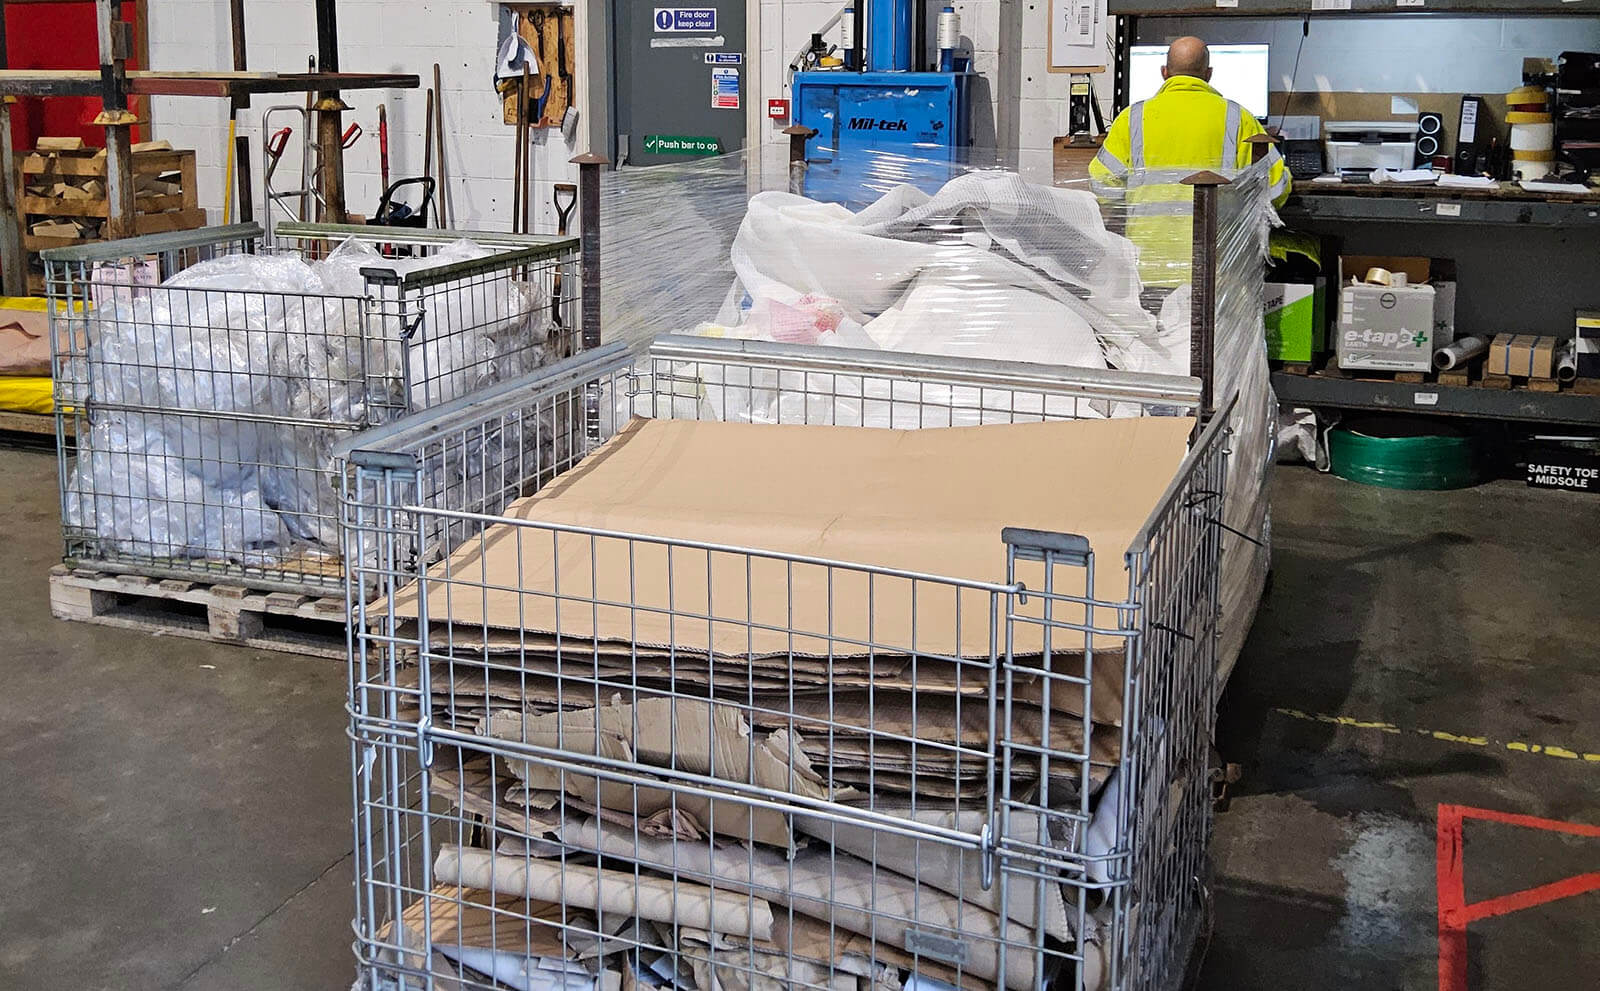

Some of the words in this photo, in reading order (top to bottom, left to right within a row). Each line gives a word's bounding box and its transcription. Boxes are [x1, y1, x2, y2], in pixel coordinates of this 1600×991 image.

[678, 20, 694, 28] keep
[848, 117, 908, 131] Mil-tek
[658, 140, 680, 149] Push
[681, 141, 695, 149] bar
[1527, 463, 1572, 476] SAFETY
[1574, 467, 1599, 478] TOE
[1535, 475, 1588, 488] MIDSOLE
